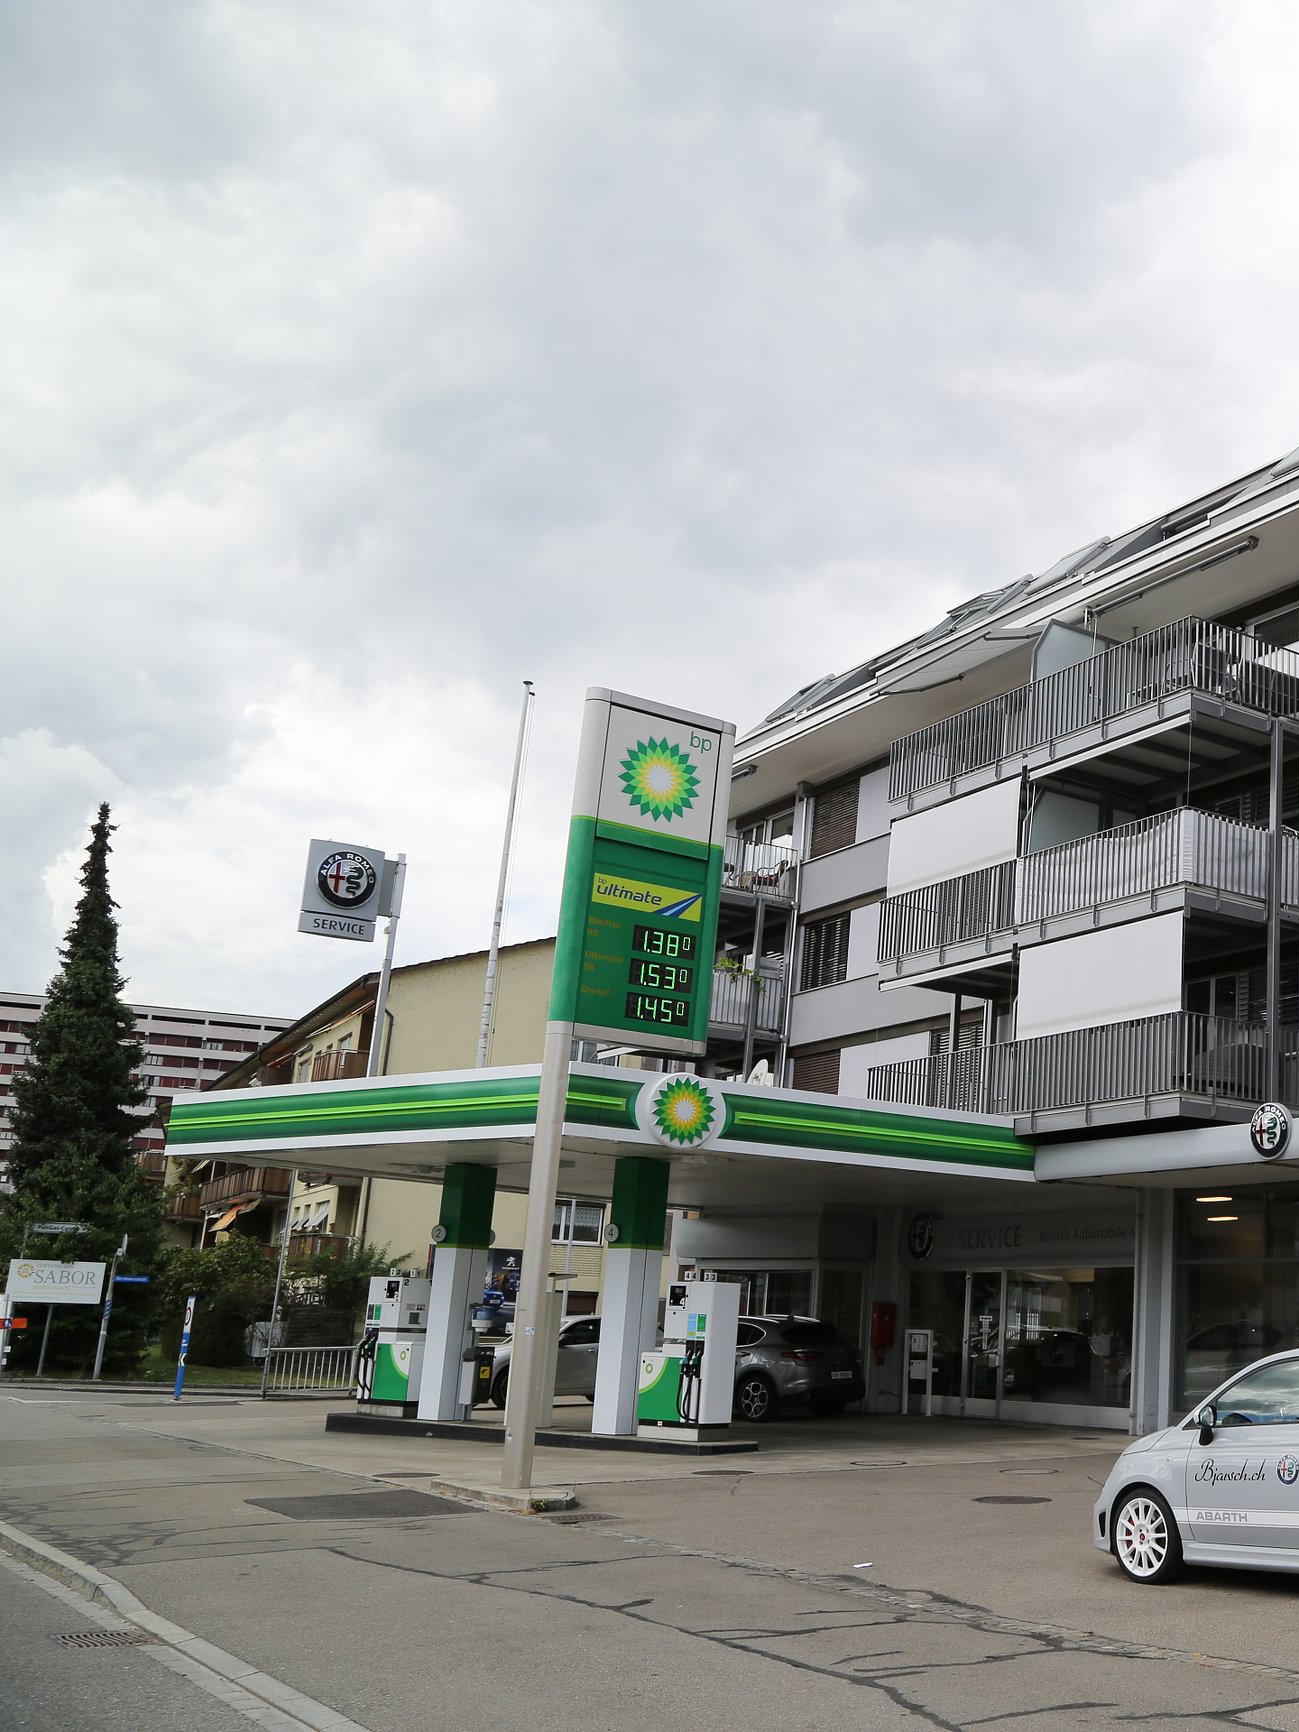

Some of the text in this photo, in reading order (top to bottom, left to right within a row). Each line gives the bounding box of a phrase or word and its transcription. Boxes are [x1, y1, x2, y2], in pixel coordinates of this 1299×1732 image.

[690, 731, 712, 754] bp
[320, 853, 375, 884] ALFA ROMEO
[596, 884, 663, 906] ultimate
[313, 918, 365, 935] SERVICE
[1264, 1105, 1287, 1130] ROMEO
[957, 1226, 1022, 1250] SERVICE
[1039, 1230, 1071, 1243] Bjarsch
[1073, 1226, 1126, 1241] Automobile
[33, 1269, 96, 1286] SABOR
[1196, 1511, 1248, 1522] ABARTH
